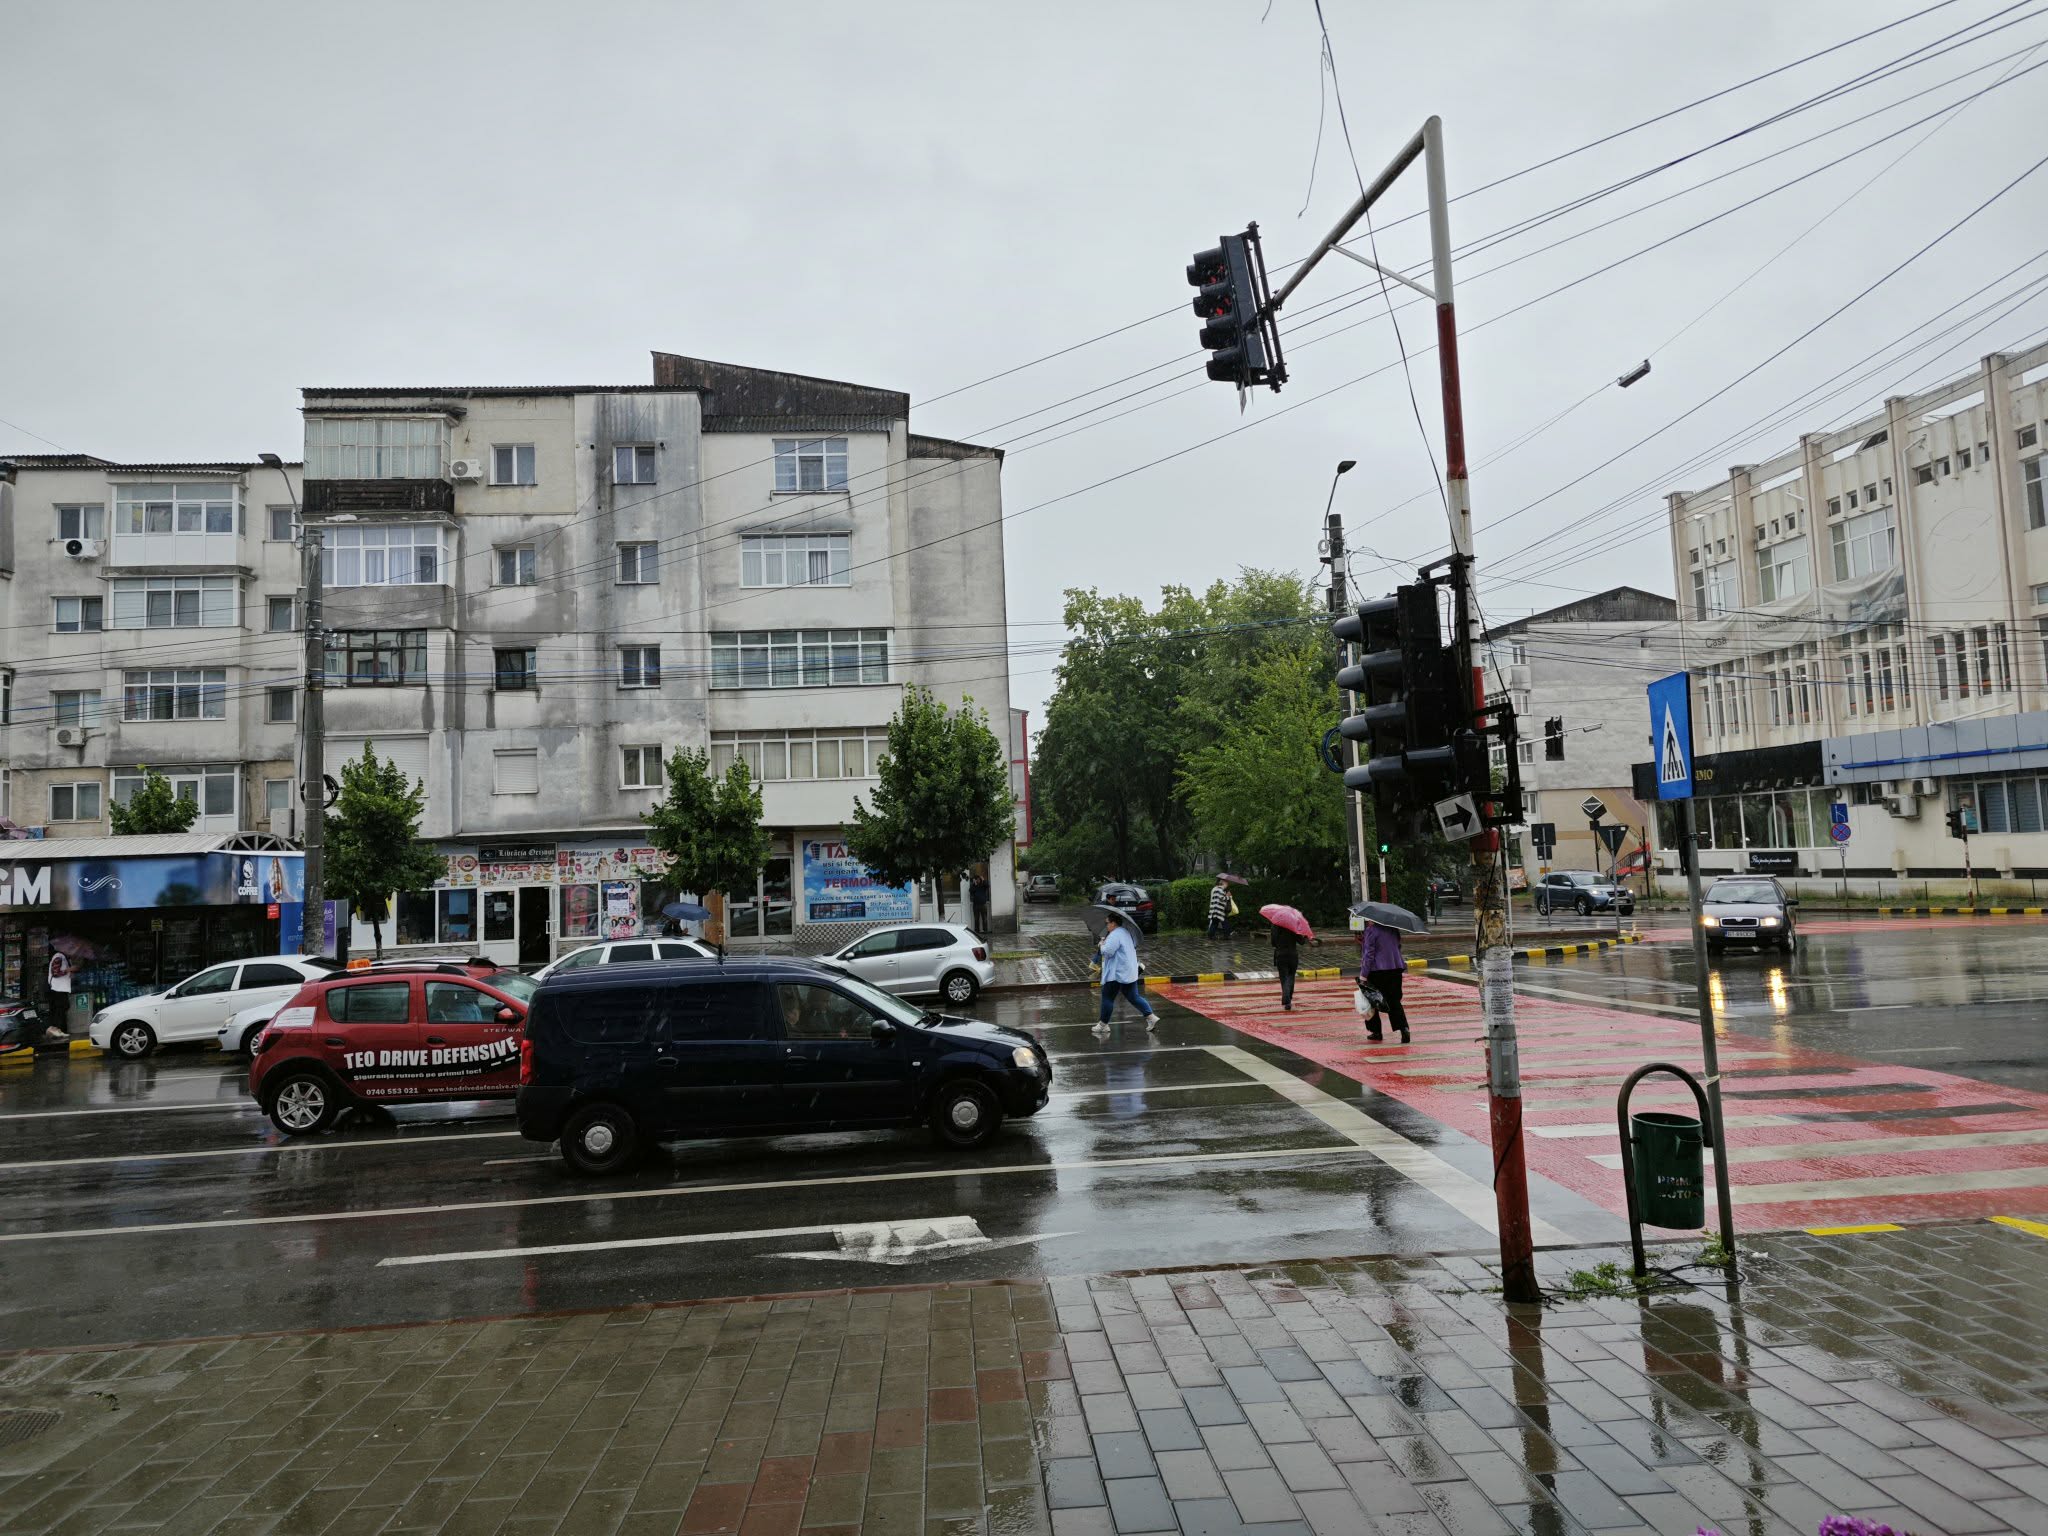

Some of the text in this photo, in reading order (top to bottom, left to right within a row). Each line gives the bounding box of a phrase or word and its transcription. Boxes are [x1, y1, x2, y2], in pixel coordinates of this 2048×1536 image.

[238, 887, 258, 895] COFFEE
[343, 1036, 519, 1070] TEO DRIVE DEFENSIVE
[366, 1088, 386, 1096] 0740
